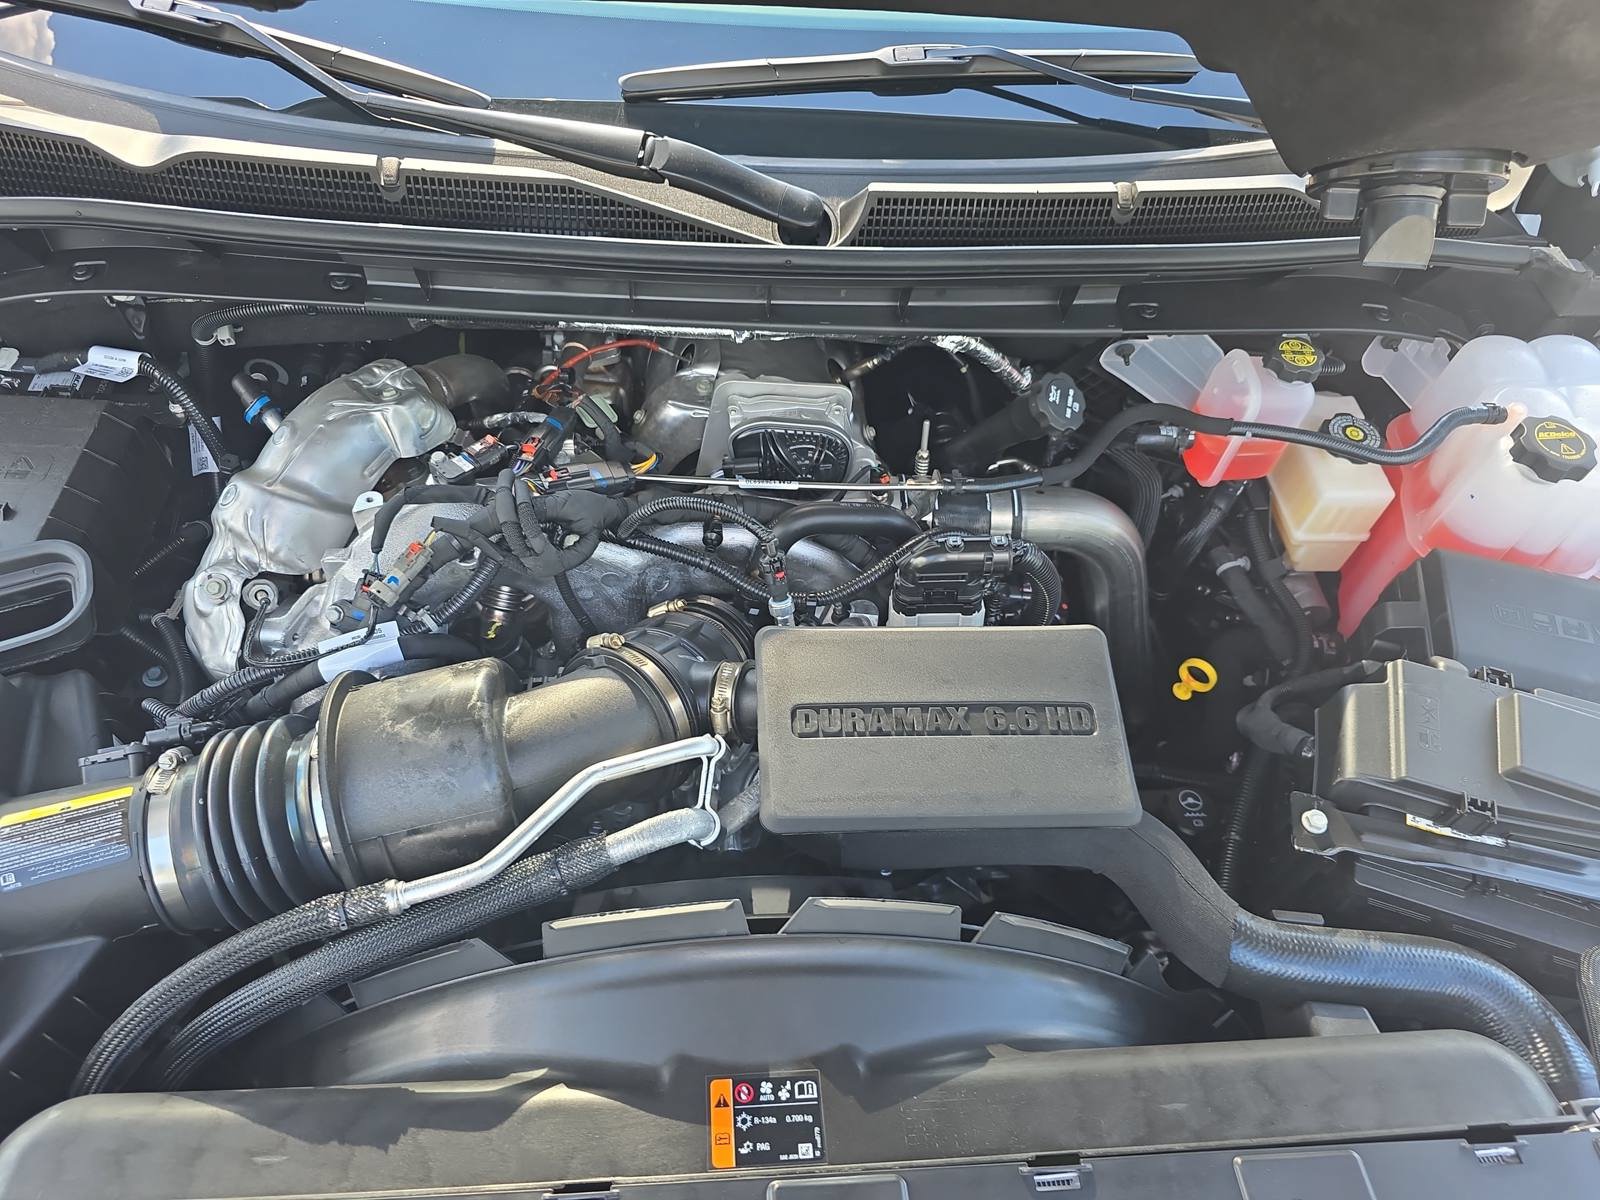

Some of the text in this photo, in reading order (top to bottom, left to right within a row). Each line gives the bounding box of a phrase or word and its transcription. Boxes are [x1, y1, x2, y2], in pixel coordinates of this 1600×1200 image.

[796, 706, 1093, 736] DURAMAX 6.6 HD
[753, 1114, 813, 1125] R-134a 0.700 kg
[756, 1142, 771, 1152] PAG
